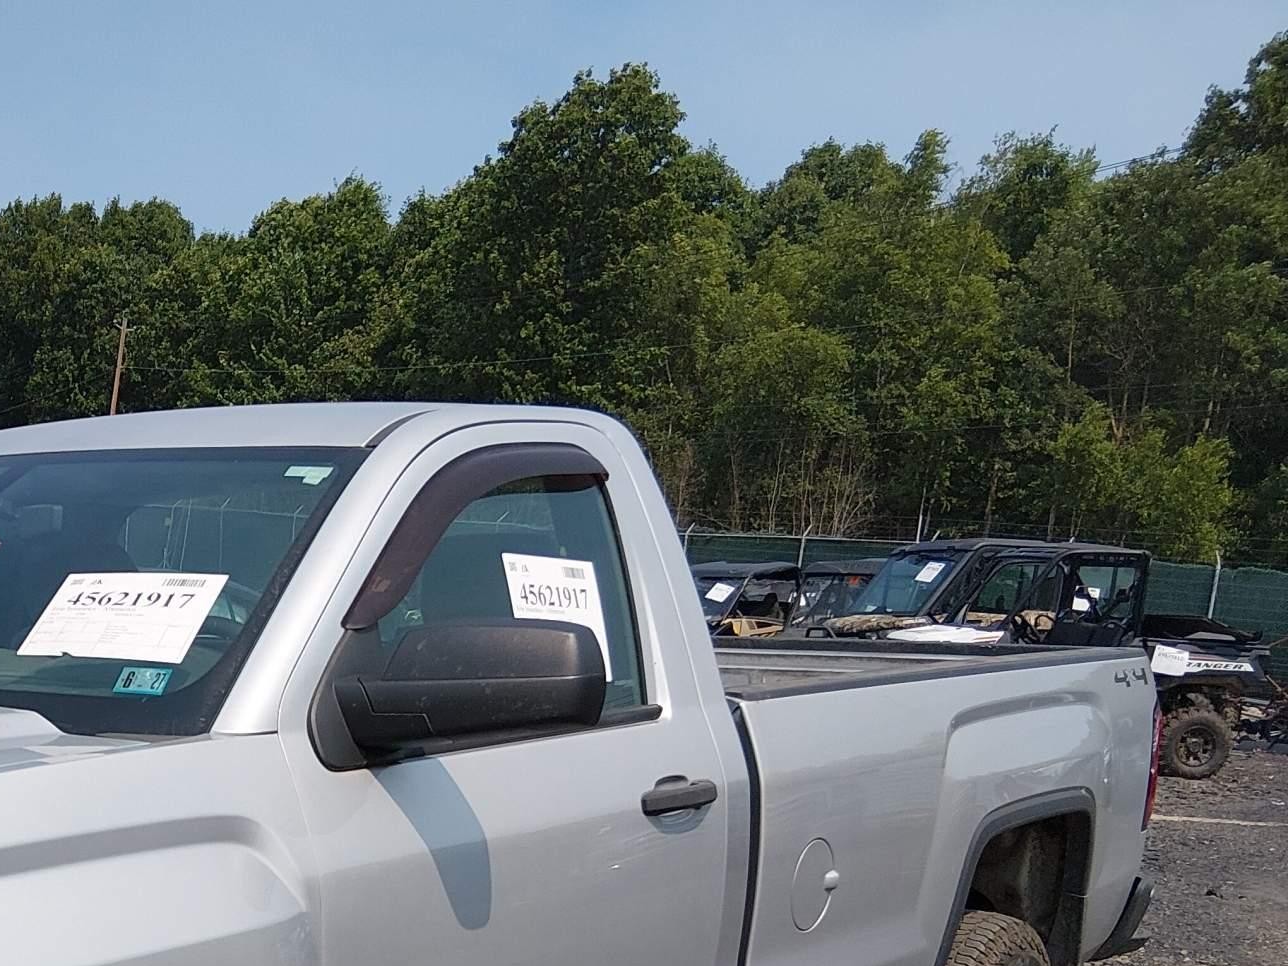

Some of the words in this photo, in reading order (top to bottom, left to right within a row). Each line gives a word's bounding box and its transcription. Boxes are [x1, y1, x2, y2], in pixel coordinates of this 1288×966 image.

[67, 591, 196, 609] 45621917
[519, 575, 588, 609] 45621917
[122, 671, 136, 688] 6
